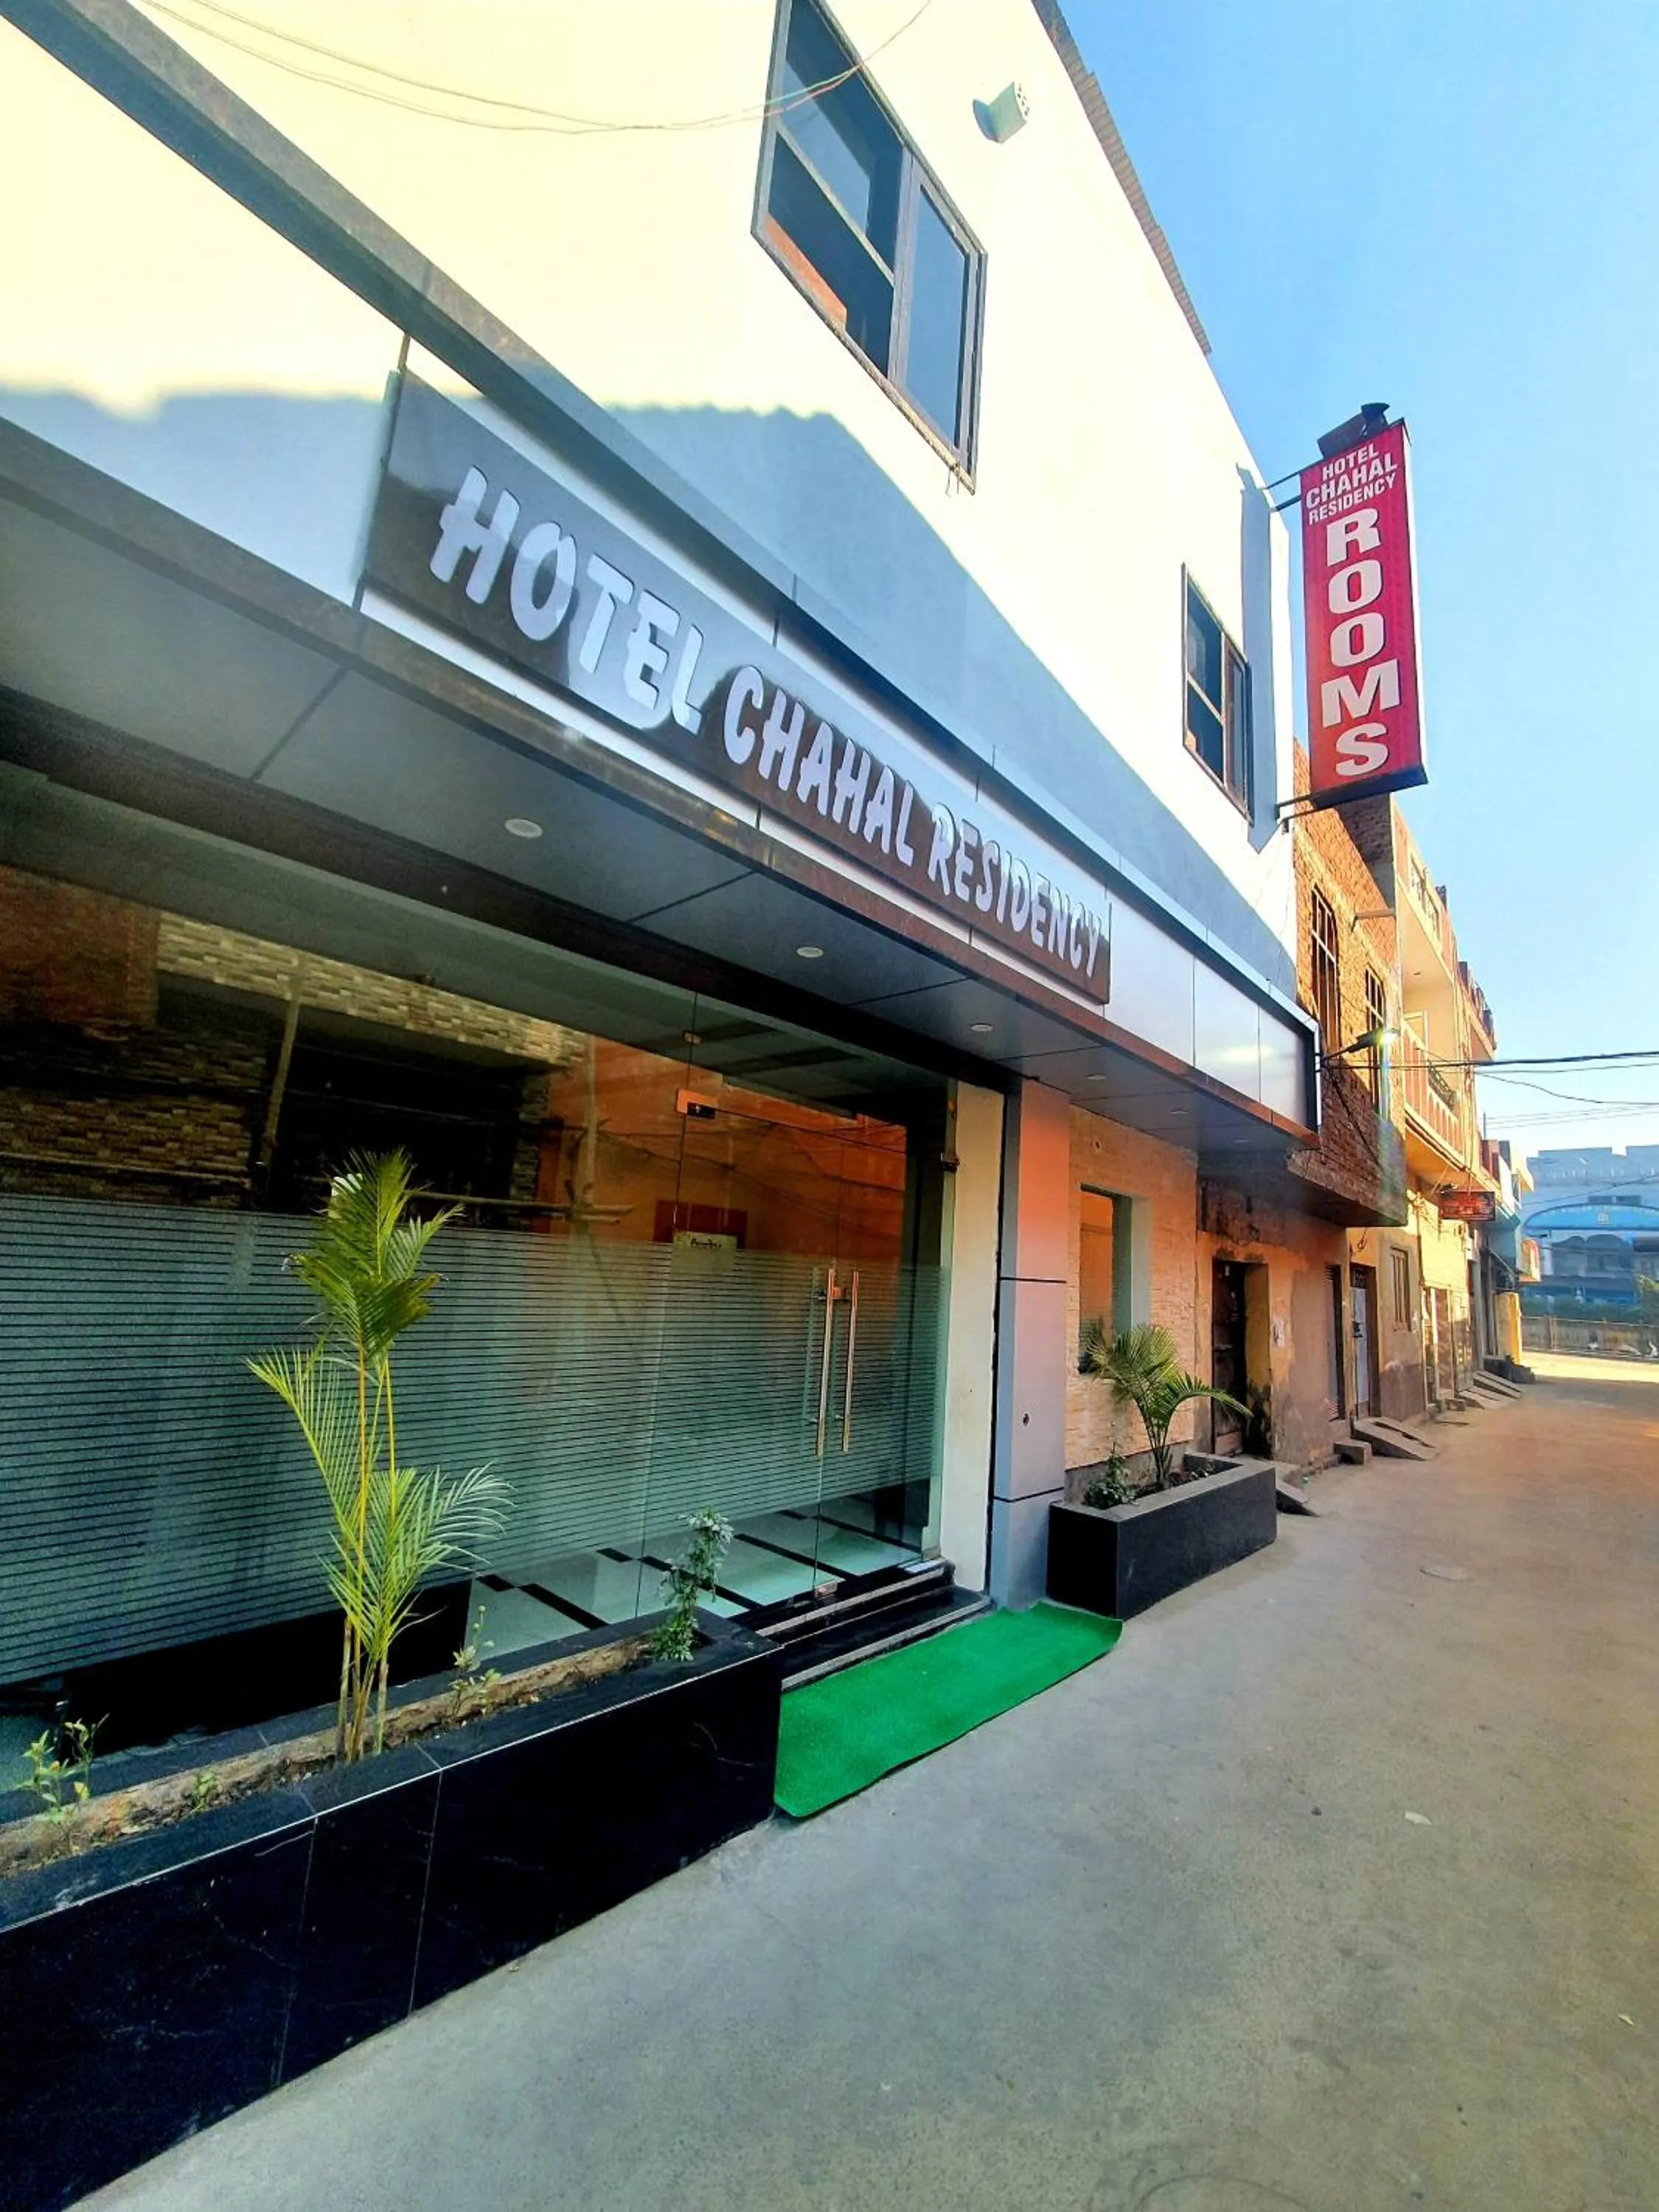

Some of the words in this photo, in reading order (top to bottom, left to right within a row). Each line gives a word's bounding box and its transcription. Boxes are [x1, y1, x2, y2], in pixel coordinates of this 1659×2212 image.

[1306, 452, 1398, 509] CHAHAL
[1322, 442, 1380, 481] HOTEL
[1309, 472, 1396, 526] RESIDENCY
[1321, 507, 1400, 777] ROOMS
[429, 465, 703, 736] HOTEL
[723, 665, 914, 867] CHAHAL
[927, 802, 1105, 978] RESIDENCY
